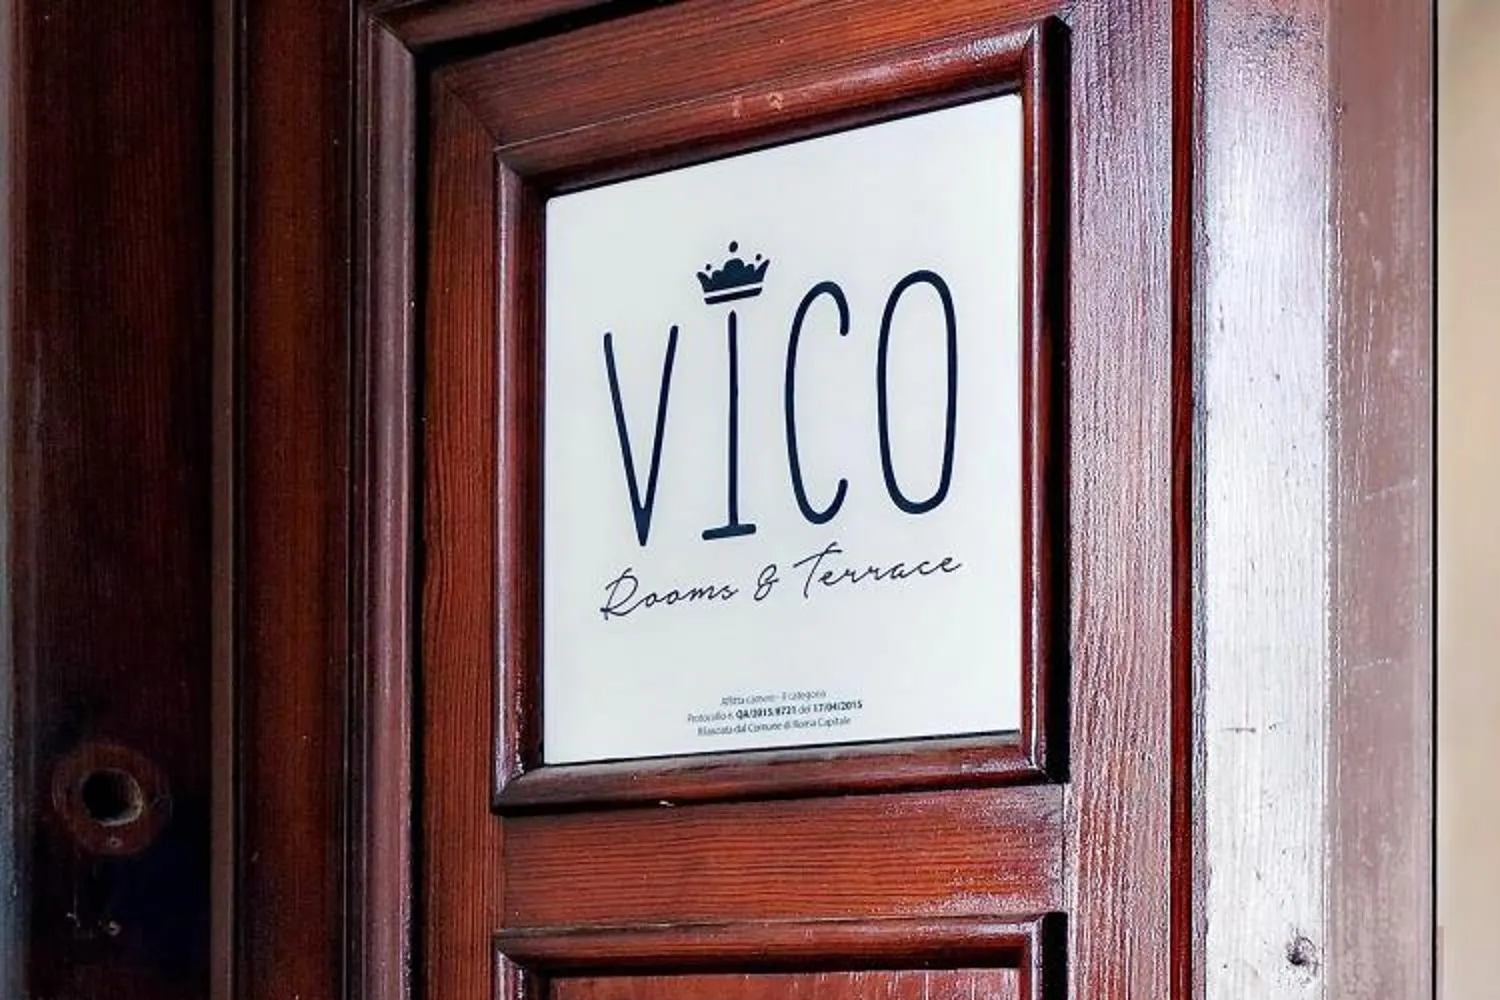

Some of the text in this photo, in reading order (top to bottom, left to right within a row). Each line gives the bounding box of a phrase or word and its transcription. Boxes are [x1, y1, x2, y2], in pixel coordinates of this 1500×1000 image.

[604, 269, 958, 548] VICO
[600, 541, 963, 620] Rooms & Terrace
